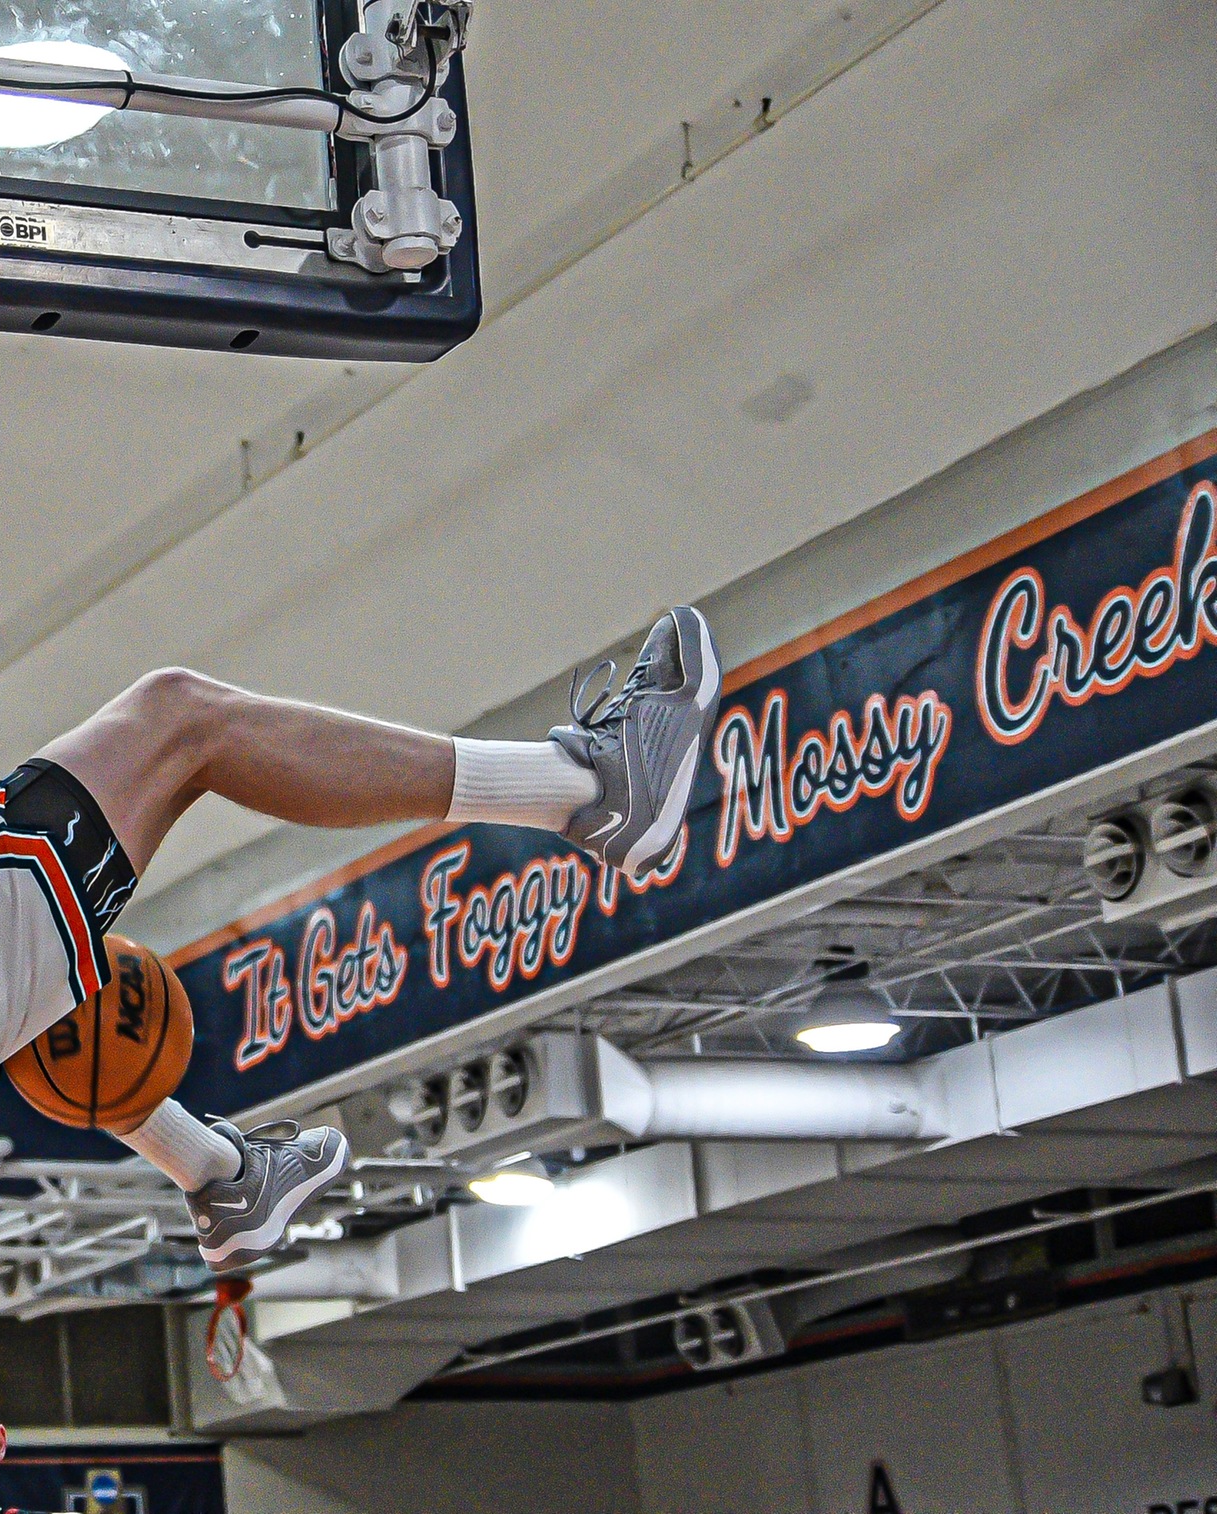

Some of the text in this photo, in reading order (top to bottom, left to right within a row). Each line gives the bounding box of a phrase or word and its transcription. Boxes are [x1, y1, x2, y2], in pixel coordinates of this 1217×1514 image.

[15, 223, 47, 241] BPI
[223, 937, 292, 1072] It
[297, 899, 407, 1040] Gets
[421, 838, 591, 992] Foggy
[714, 688, 952, 868] Mossy
[975, 479, 1217, 746] Creek
